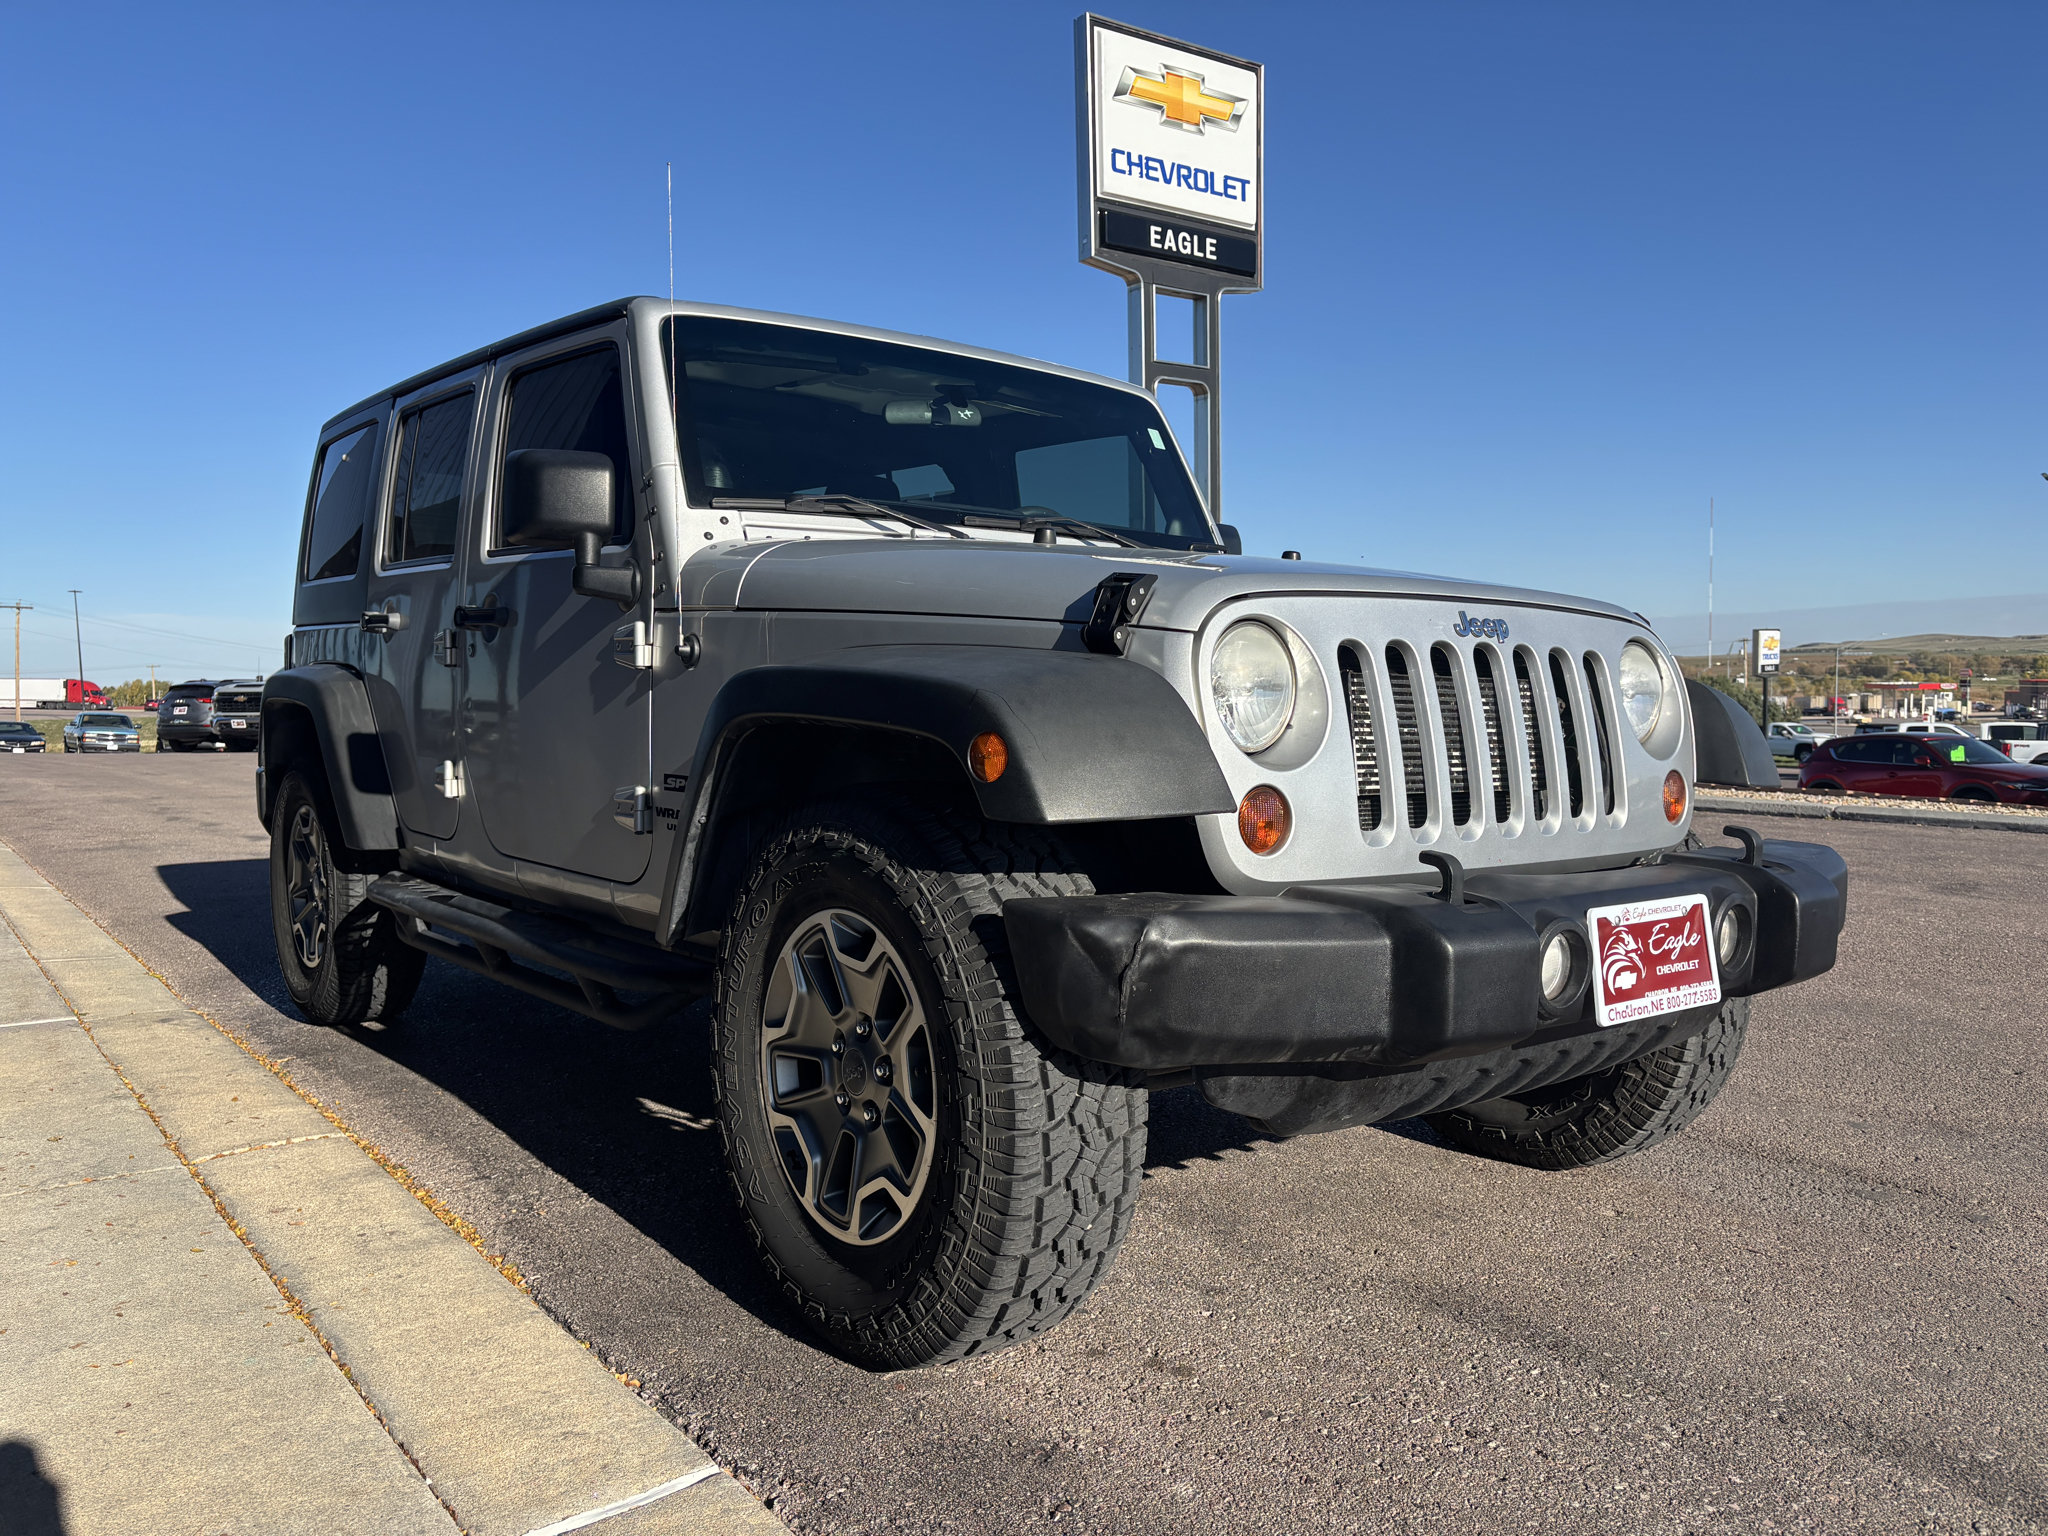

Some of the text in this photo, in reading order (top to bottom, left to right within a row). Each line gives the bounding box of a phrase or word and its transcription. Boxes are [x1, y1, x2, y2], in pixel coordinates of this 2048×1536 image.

[1111, 147, 1251, 203] CHEVROLET
[1149, 224, 1218, 261] EAGLE
[1453, 610, 1510, 644] Jeep
[666, 777, 687, 789] SP
[1648, 904, 1682, 915] CHEVROLET
[1647, 922, 1701, 960] Eagle
[1656, 959, 1700, 976] CHEVROLET
[721, 897, 771, 1206] ADVENTURO
